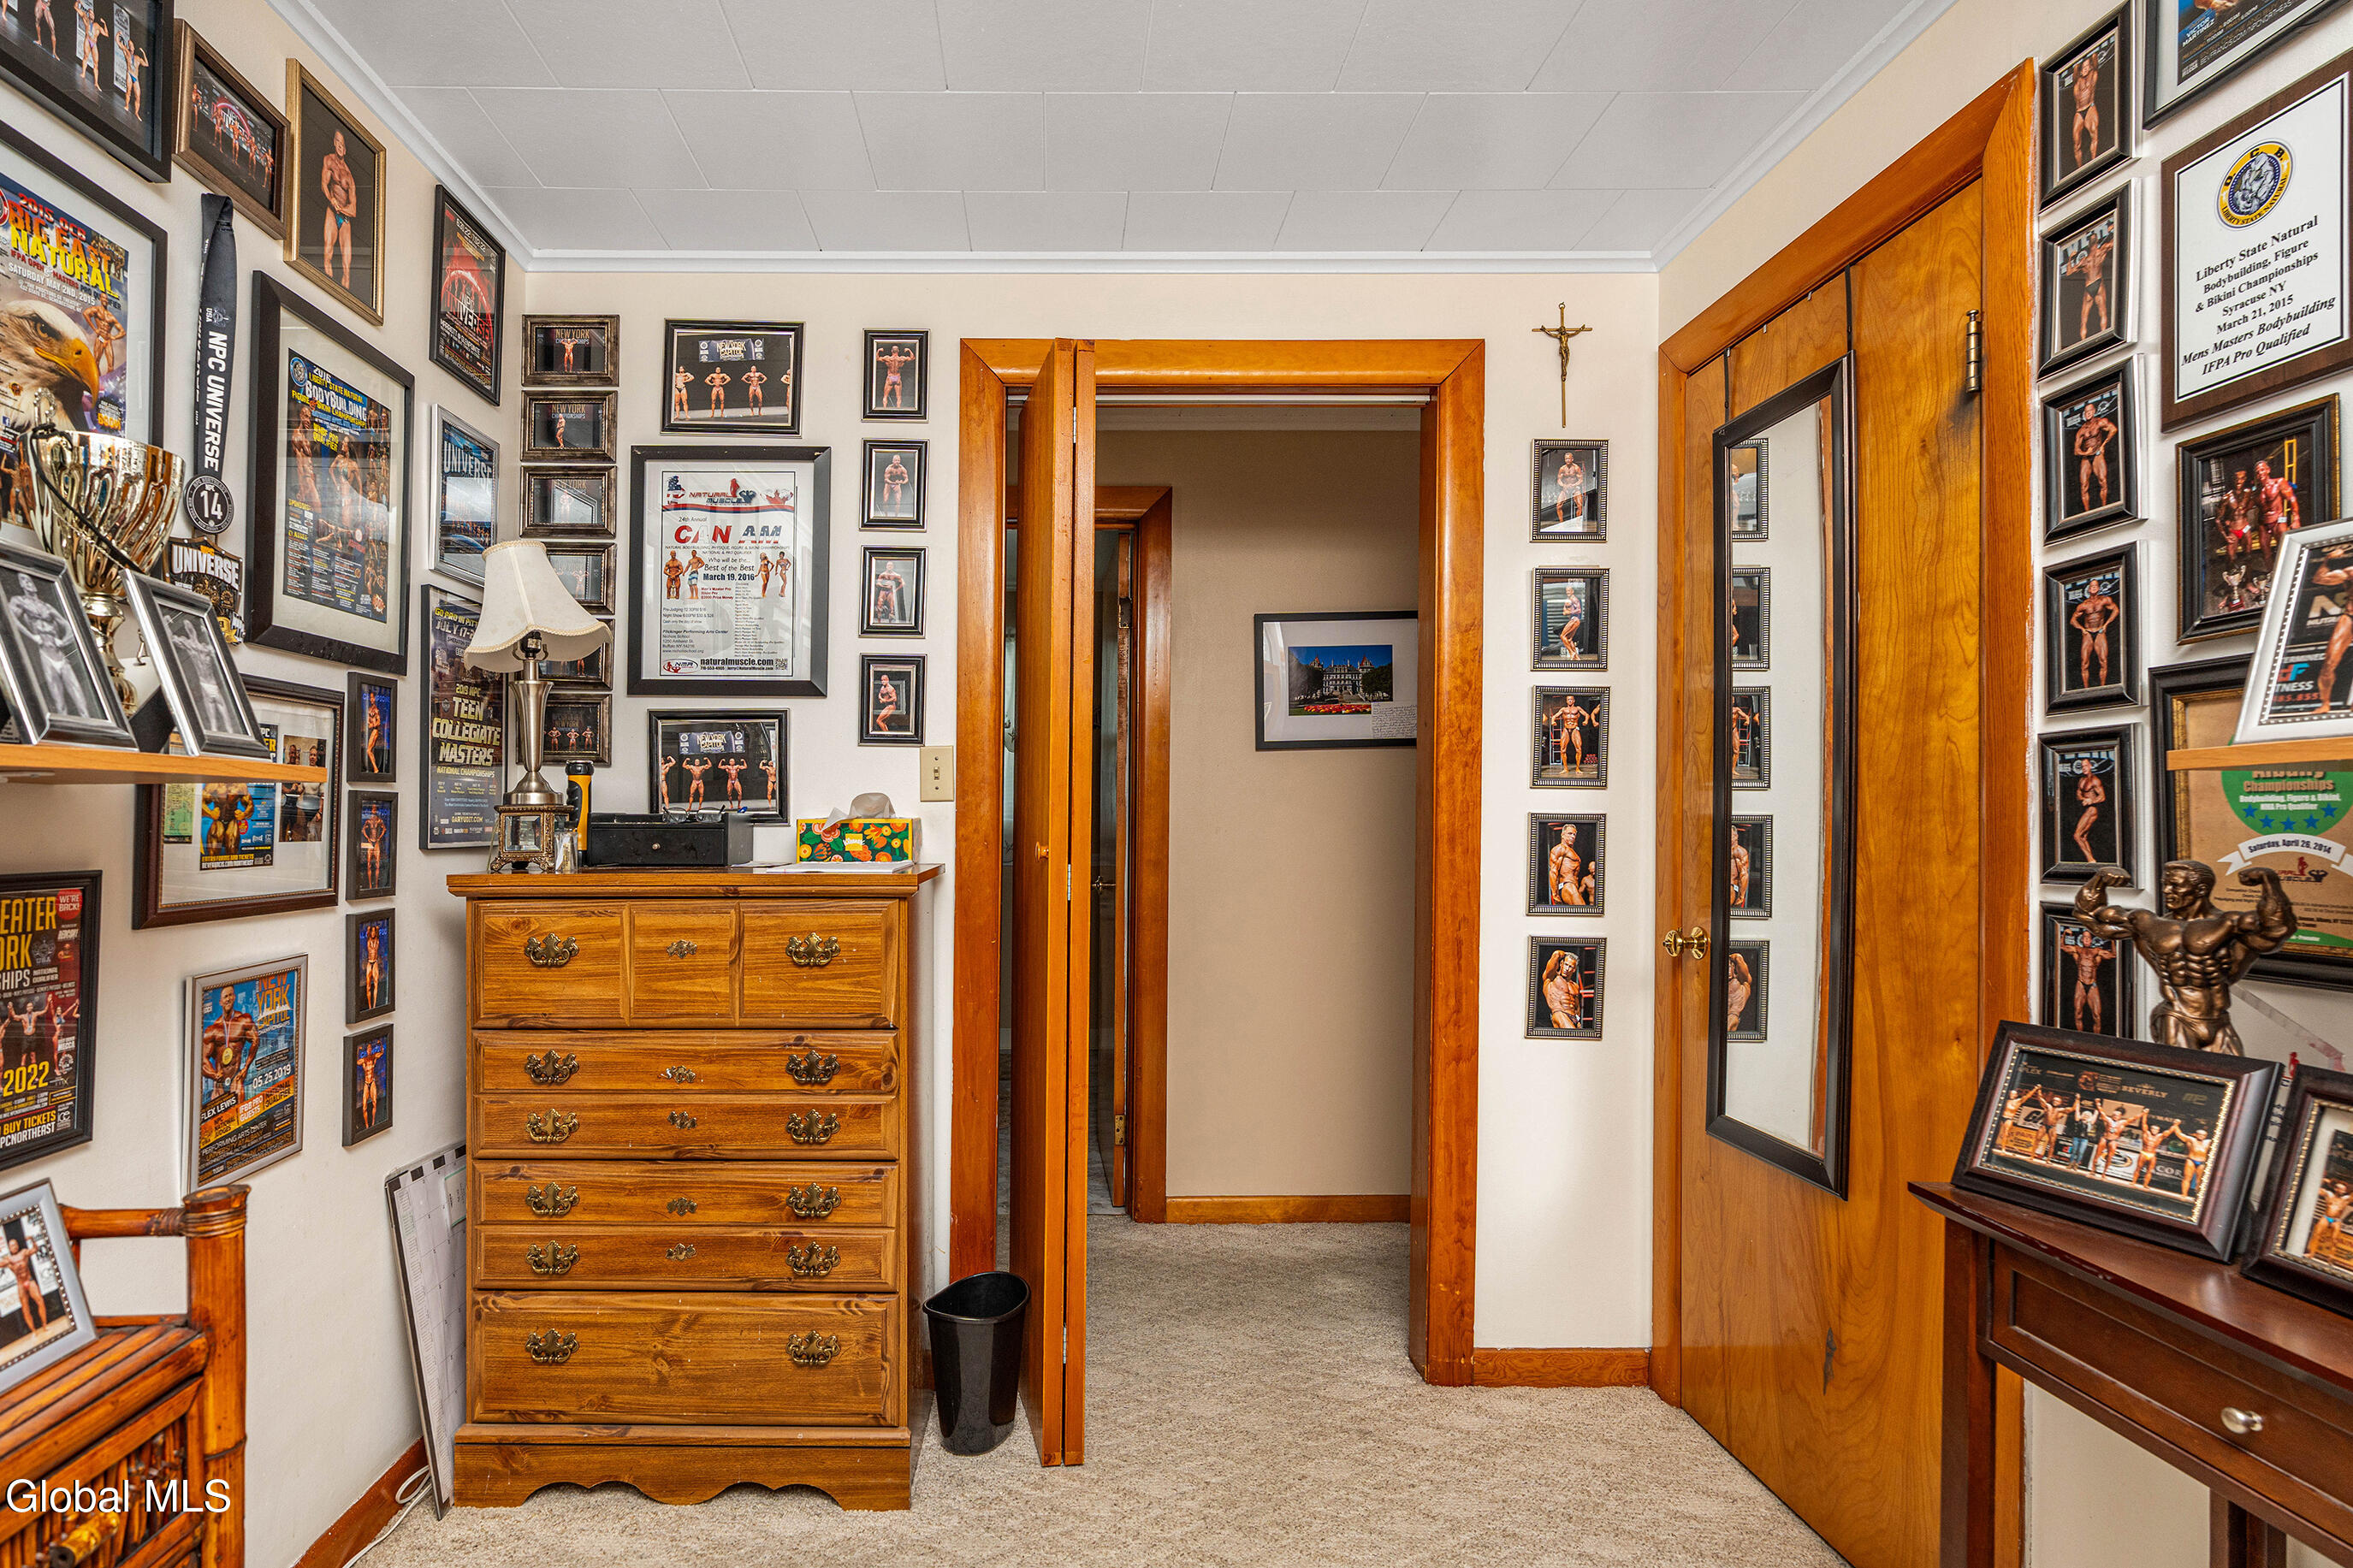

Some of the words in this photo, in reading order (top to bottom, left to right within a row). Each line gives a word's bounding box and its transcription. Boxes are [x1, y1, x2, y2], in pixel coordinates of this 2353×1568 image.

[2182, 18, 2216, 47] MARTINEZ
[2186, 15, 2211, 38] VICTOR
[2222, 206, 2241, 225] LIBERTY
[2242, 211, 2263, 225] STATE
[2264, 176, 2287, 212] NATURAL
[18, 192, 55, 223] 2015
[59, 216, 86, 242] OCB
[8, 199, 51, 245] BIG
[55, 225, 111, 278] EAST
[2196, 256, 2236, 282] Liberty
[2238, 241, 2267, 262] State
[2270, 215, 2319, 247] Natural
[10, 249, 27, 264] IFPA
[27, 257, 44, 273] OPEN
[52, 271, 80, 290] MASTERS
[80, 284, 93, 297] PRO
[11, 225, 120, 300] NATURAL
[2203, 258, 2272, 295] Bodybuilding,
[2273, 240, 2309, 263] Figure
[8, 263, 44, 283] SATURDAY
[46, 279, 61, 293] MAY
[62, 286, 78, 301] 2ND,
[79, 293, 96, 306] 2015
[2195, 302, 2204, 313] &
[2207, 287, 2236, 309] Bikini
[2237, 251, 2319, 293] Championships
[2222, 292, 2267, 317] Syracuse
[2269, 280, 2287, 297] NY
[2216, 314, 2249, 335] March
[2251, 307, 2267, 321] 21,
[2269, 293, 2294, 313] 2015
[555, 328, 571, 339] NEW
[572, 328, 590, 339] YORK
[2181, 349, 2209, 367] Mens
[2211, 329, 2254, 354] Masters
[2256, 296, 2337, 336] Bodybuilding
[207, 331, 228, 371] NPC
[716, 341, 730, 353] NEW
[730, 340, 746, 352] YORK
[2202, 353, 2231, 376] IFPA
[2232, 349, 2253, 364] Pro
[2255, 322, 2311, 355] Qualified
[312, 365, 331, 383] 2016
[292, 389, 310, 405] FIGURE
[309, 372, 328, 388] LIBERTY
[329, 383, 344, 395] STATE
[344, 388, 364, 405] NATURAL
[305, 381, 368, 423] BODYBUILDING
[552, 403, 566, 413] NEW
[567, 403, 586, 413] YORK
[204, 375, 226, 472] UNIVERSE
[443, 440, 493, 497] UNIVERSE
[200, 490, 223, 520] 14
[674, 525, 732, 544] CAN
[738, 525, 782, 544] AM
[172, 543, 240, 592] UNIVERSE
[727, 573, 737, 582] 19,
[435, 607, 444, 617] GO
[444, 610, 458, 621] PRO
[458, 615, 465, 624] IN
[436, 618, 459, 635] JULY
[469, 687, 482, 697] NPC
[452, 696, 484, 721] TEEN
[431, 717, 501, 746] COLLEGIATE
[696, 735, 709, 745] NEW
[709, 734, 726, 744] YORK
[439, 742, 495, 766] MASTERS
[436, 766, 459, 775] NATIONAL
[460, 768, 495, 778] CHAMPIONSHIPS
[2243, 779, 2334, 793] Championships
[2248, 840, 2279, 854] Saturday,
[2314, 842, 2332, 854] 2014
[58, 902, 80, 912] BACK!
[59, 894, 80, 903] WE'RE
[0, 896, 56, 935] EATER
[33, 967, 58, 977] NATIONAL
[33, 973, 59, 984] QUALIFIER
[259, 973, 288, 992] NEW
[257, 984, 291, 1015] YORK
[258, 1009, 291, 1031] CAPITOL
[258, 1021, 291, 1036] CHAMPIONSHIPS
[3, 1060, 50, 1098] 2022
[252, 1063, 292, 1090] 05.25.2019
[240, 1100, 252, 1113] IFBB
[252, 1094, 264, 1107] PRO
[2122, 1085, 2168, 1098] BEVERLY
[201, 1104, 216, 1121] FLEX
[216, 1096, 238, 1112] LEWIS
[240, 1105, 261, 1124] GUESTS
[3, 1121, 21, 1136] BUY
[24, 1109, 56, 1128] TICKETS
[202, 1134, 238, 1157] PERFORMING
[237, 1128, 251, 1140] ARTS
[250, 1120, 268, 1135] CENTER
